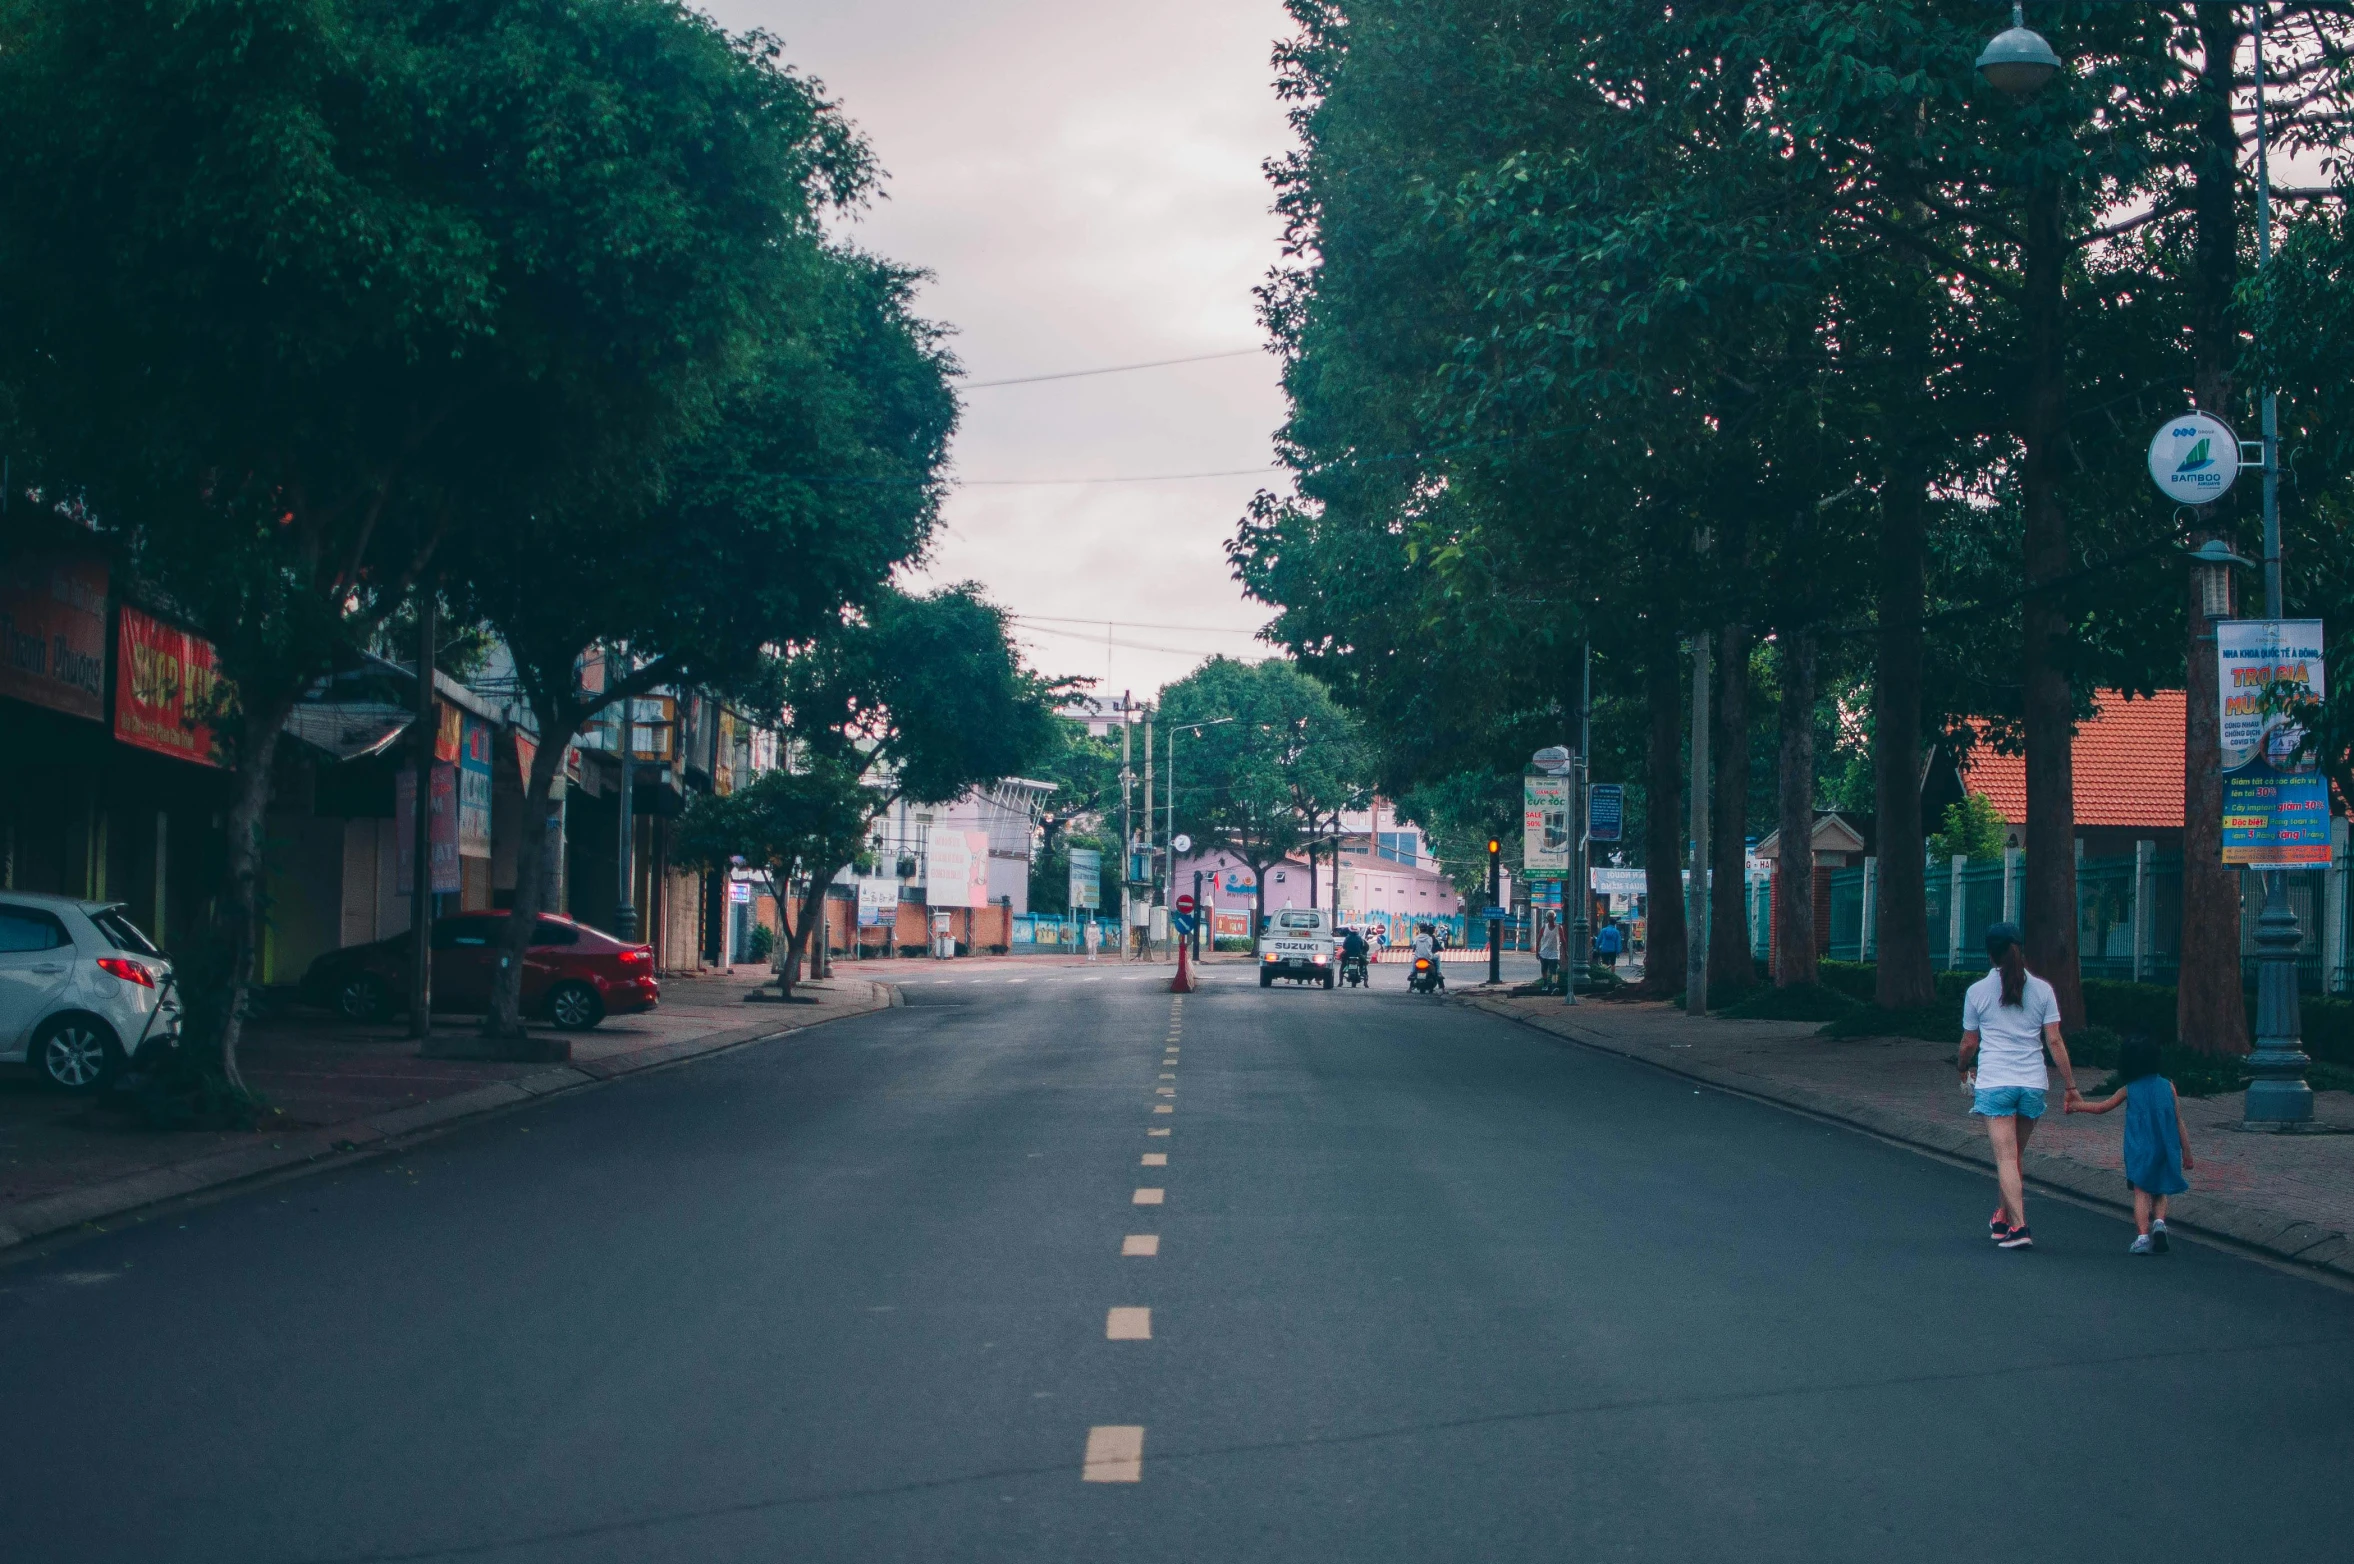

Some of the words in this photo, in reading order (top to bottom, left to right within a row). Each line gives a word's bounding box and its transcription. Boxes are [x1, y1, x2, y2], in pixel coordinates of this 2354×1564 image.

[2171, 474, 2221, 482] BAMBOO
[2240, 649, 2259, 658] KHOA
[2261, 646, 2280, 659] QUỐC
[131, 642, 180, 711] SHOP
[2231, 665, 2271, 691] TRỢ
[2275, 660, 2309, 683] GIÁ
[2290, 776, 2306, 786] dịch
[2231, 789, 2243, 797] lên
[2257, 787, 2277, 797] 30%
[2247, 804, 2276, 812] implant
[2277, 800, 2302, 812] giảm
[2304, 800, 2324, 810] 30%
[2248, 829, 2254, 839] 3
[1274, 942, 1319, 951] SUZUKI
